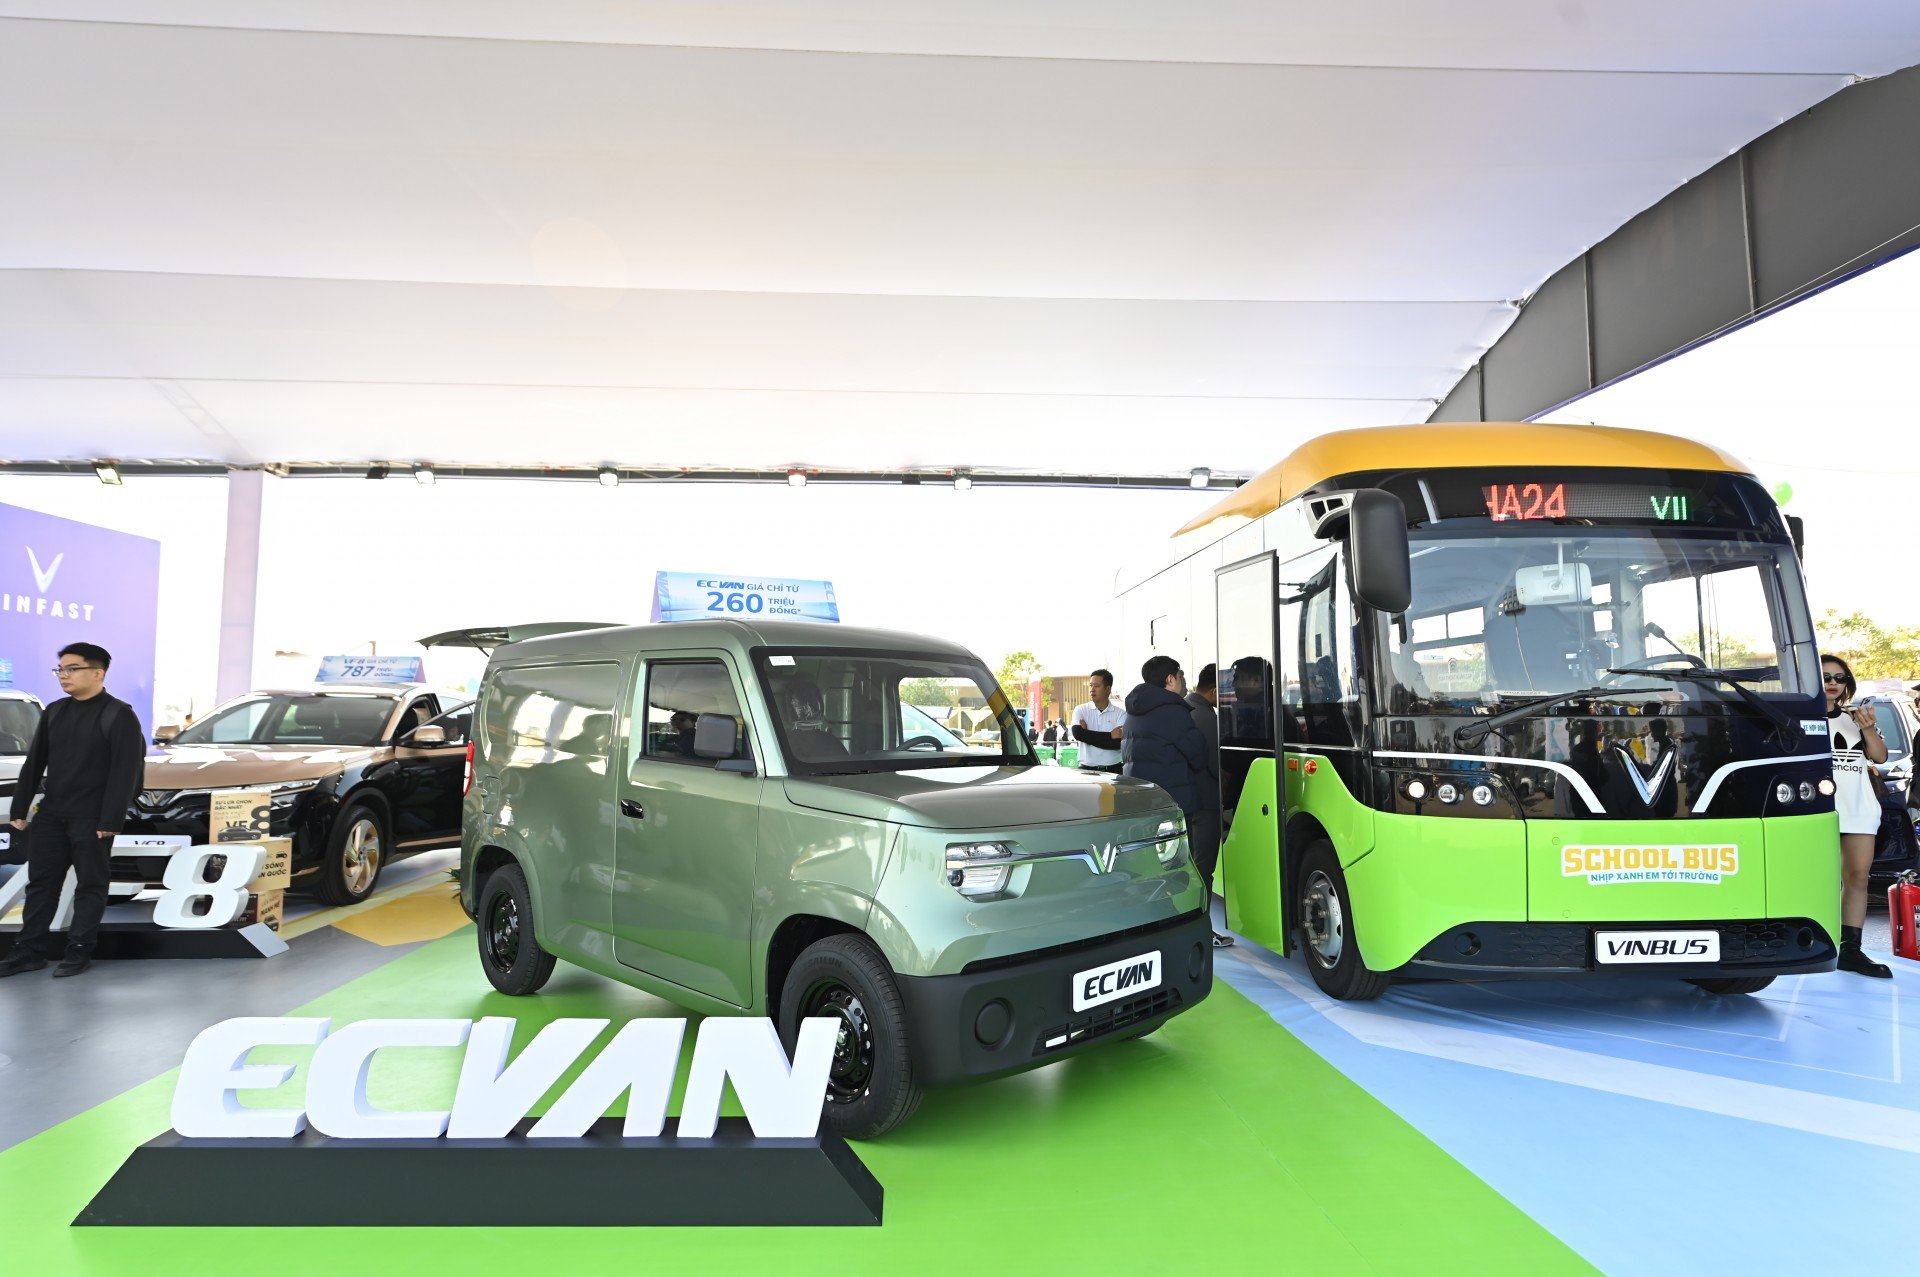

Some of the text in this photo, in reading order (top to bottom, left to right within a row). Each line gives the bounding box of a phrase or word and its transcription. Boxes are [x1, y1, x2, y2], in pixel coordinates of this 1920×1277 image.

[747, 583, 764, 591] GIÁ
[3, 593, 95, 622] INFAST
[707, 591, 763, 614] 260
[341, 665, 376, 677] 787
[1832, 764, 1863, 775] enciag
[1564, 847, 1736, 873] SCHOOL BUS
[1590, 870, 1719, 883] NHỊP XANH EM TỚI TRƯỜNG
[1607, 940, 1710, 956] VINBUS
